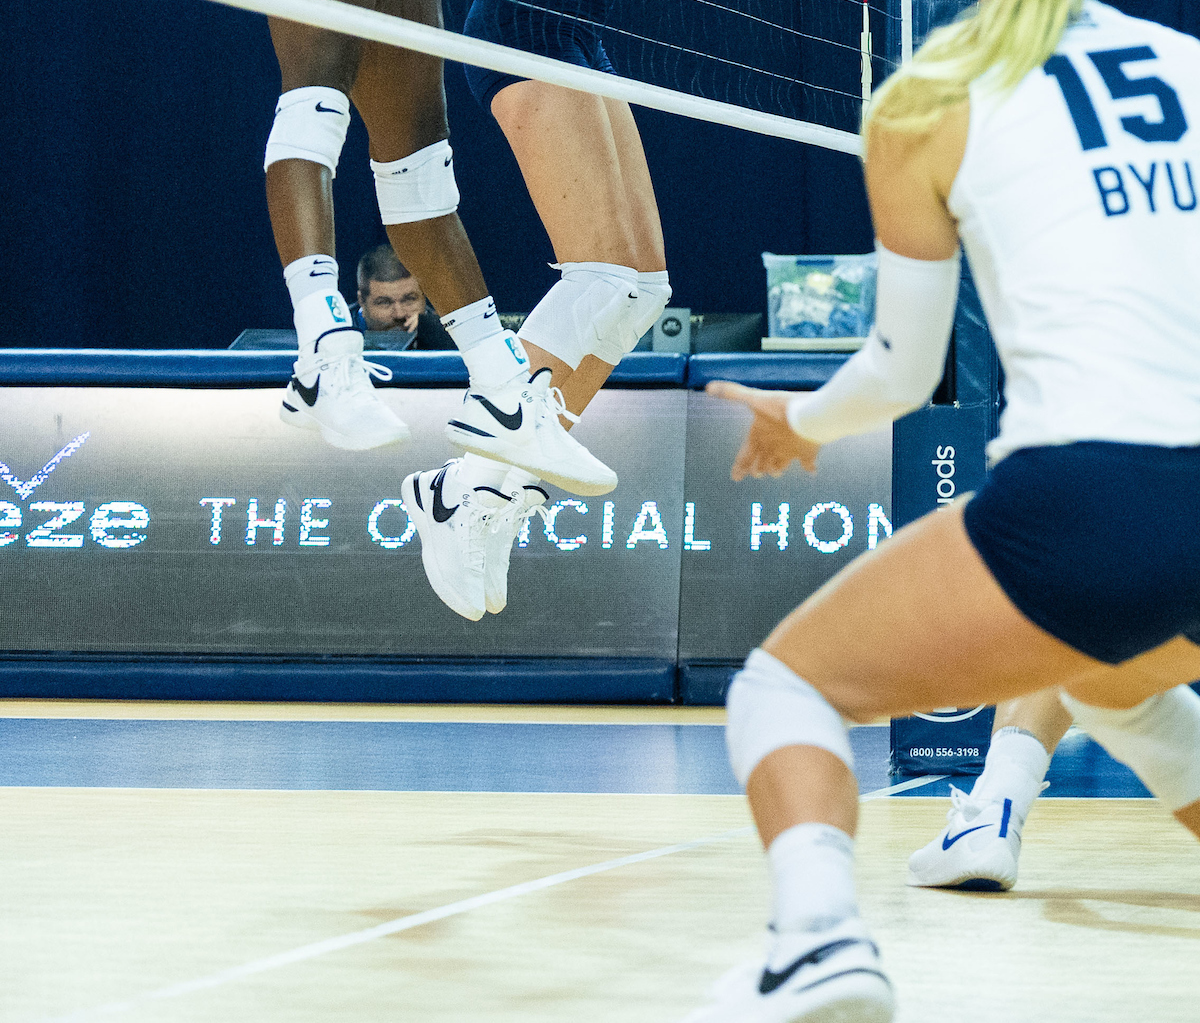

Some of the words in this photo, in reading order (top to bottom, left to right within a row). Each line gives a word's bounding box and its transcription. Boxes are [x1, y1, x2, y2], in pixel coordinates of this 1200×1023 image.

[1042, 45, 1189, 152] 15
[1091, 160, 1198, 218] BYU
[199, 497, 331, 546] THE
[367, 498, 711, 552] OICIAL
[909, 747, 934, 758] (800)
[935, 747, 980, 757] 556-3198
